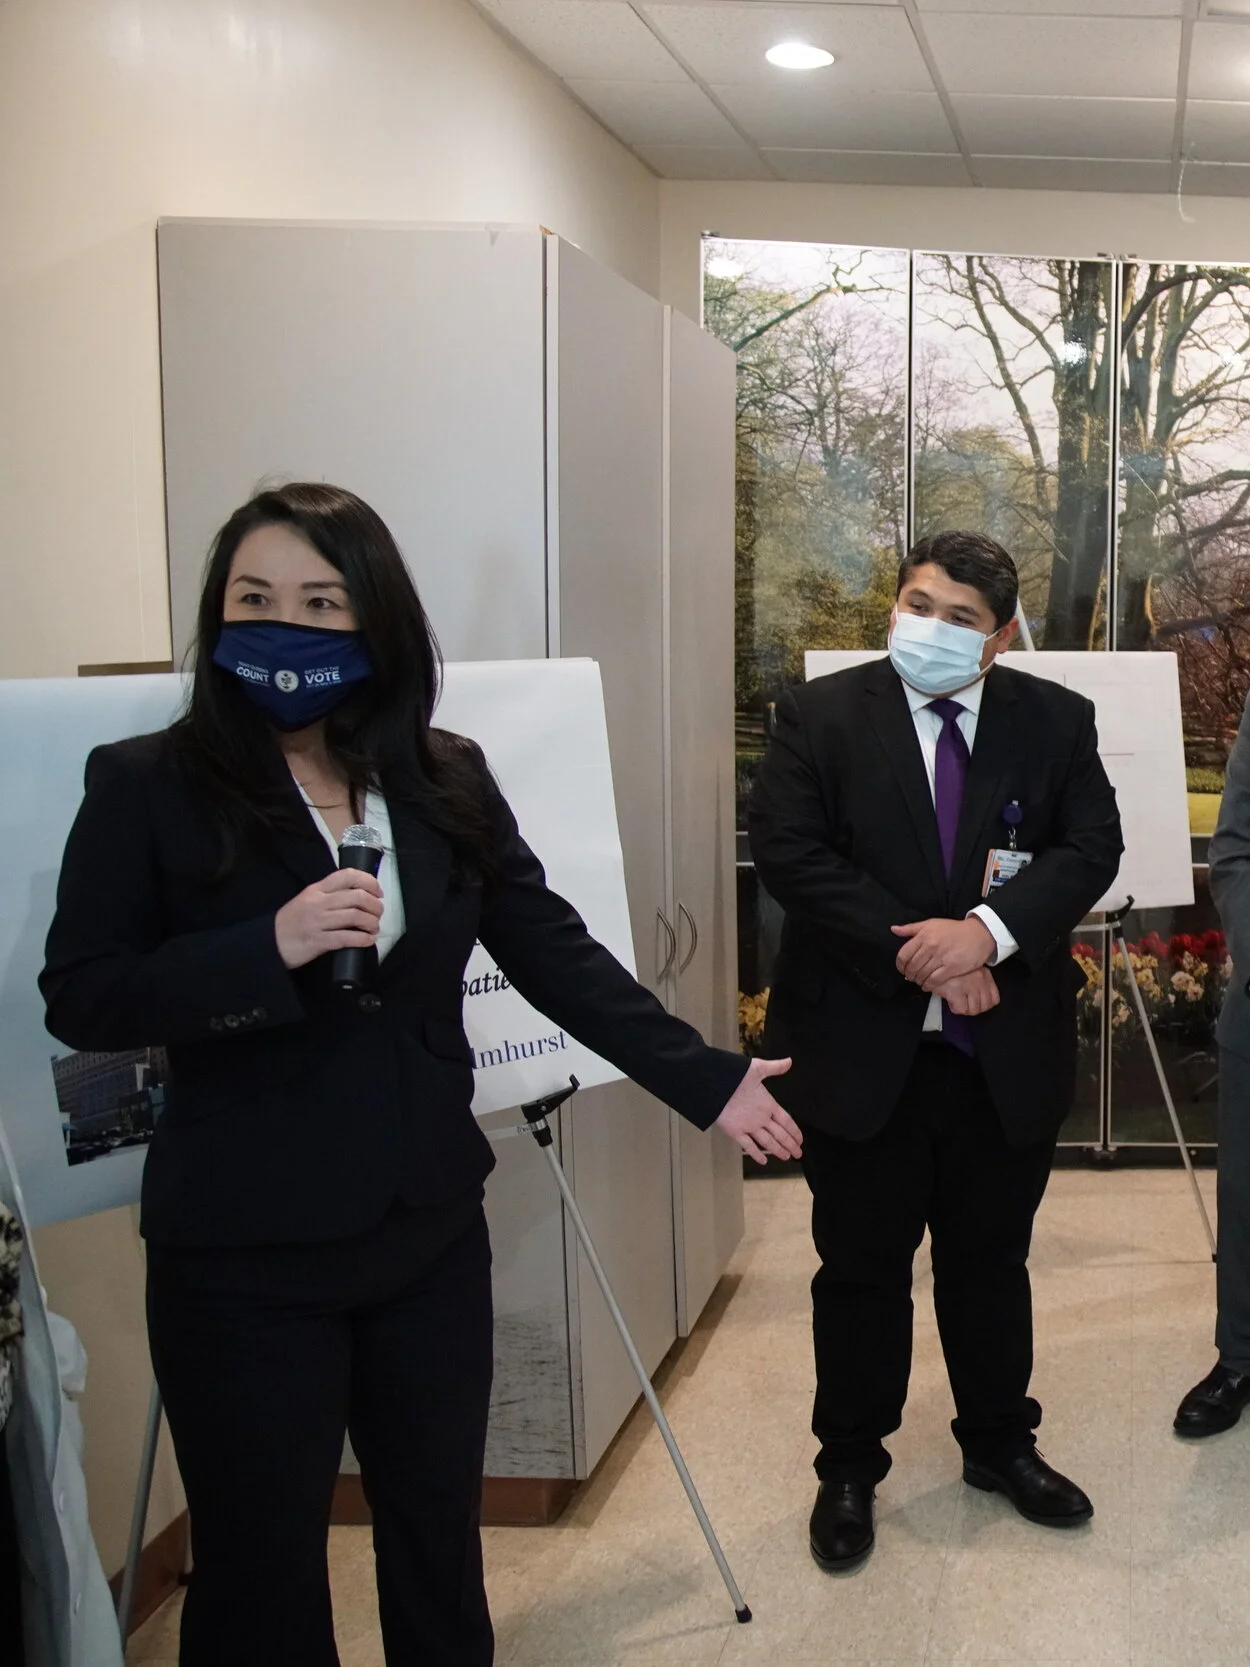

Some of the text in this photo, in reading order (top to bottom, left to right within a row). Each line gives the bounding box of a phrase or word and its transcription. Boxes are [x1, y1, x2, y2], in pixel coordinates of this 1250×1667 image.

[236, 666, 270, 683] COUNT
[304, 670, 341, 684] VOTE
[469, 1030, 569, 1070] lmhurst
